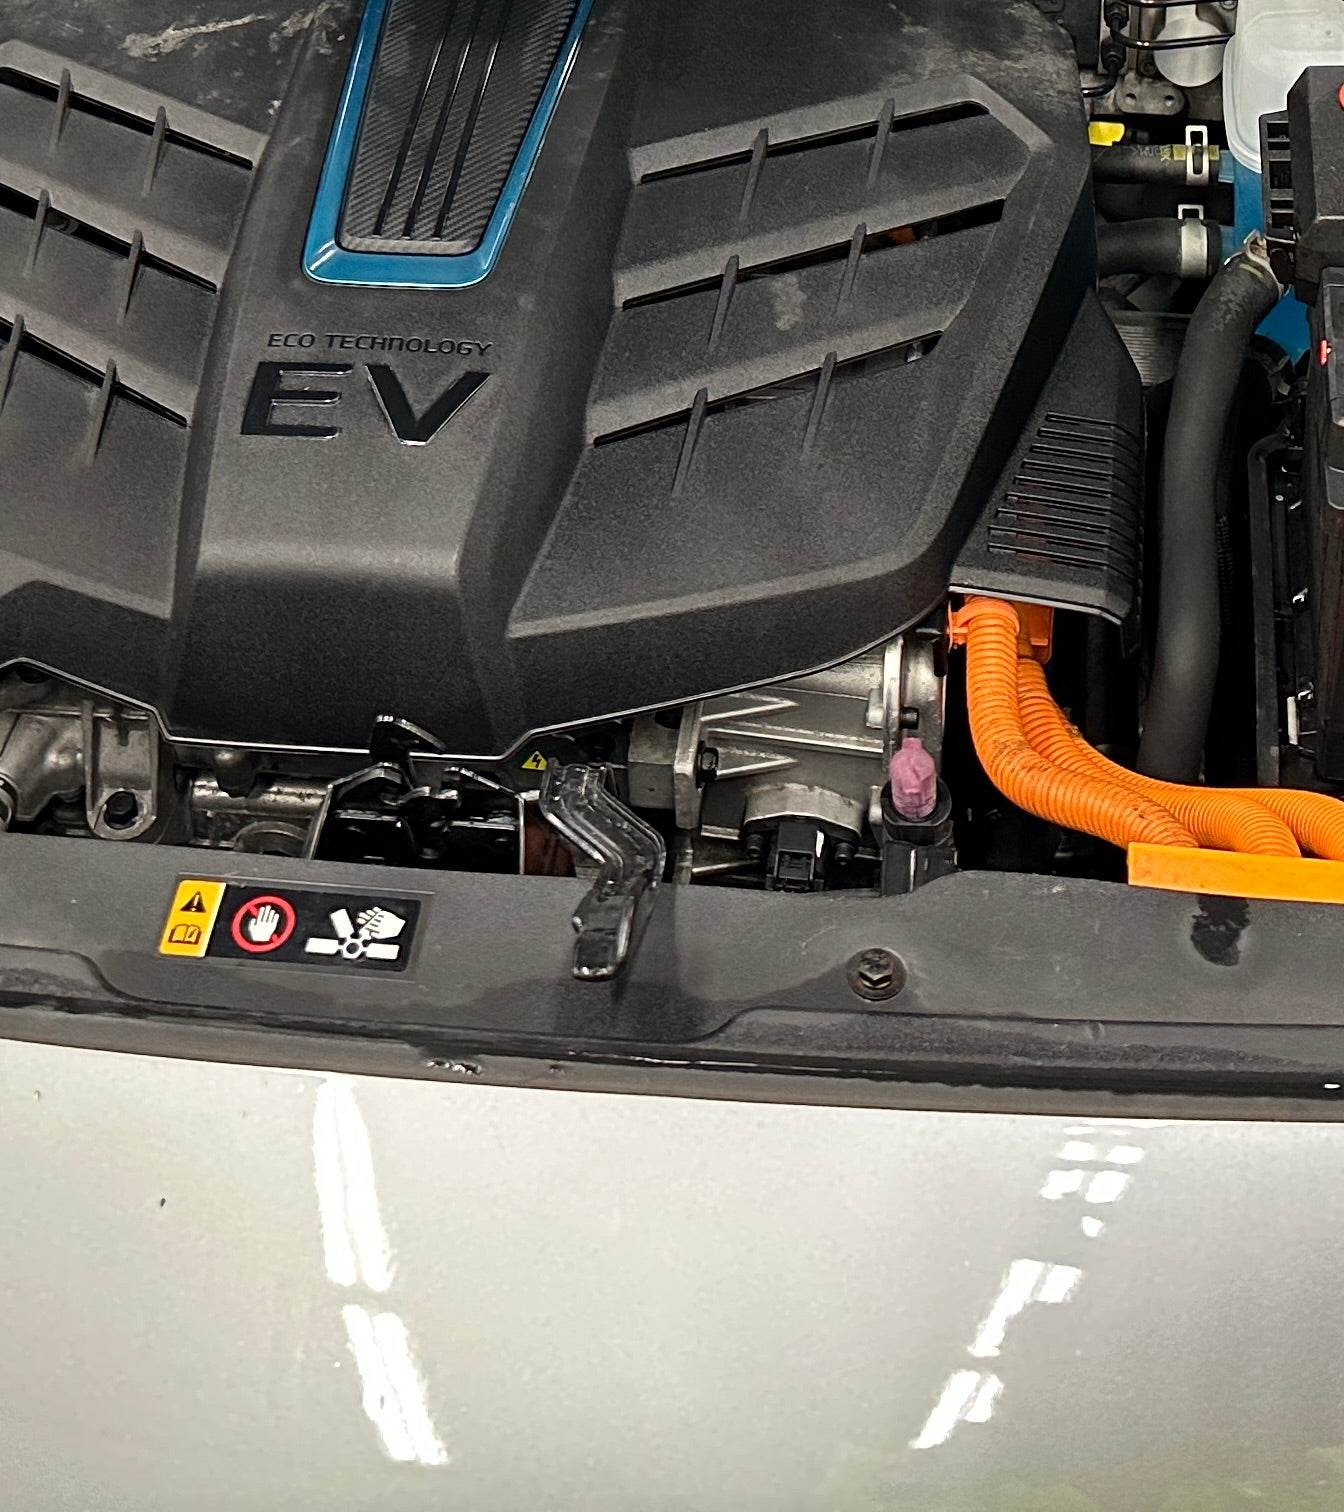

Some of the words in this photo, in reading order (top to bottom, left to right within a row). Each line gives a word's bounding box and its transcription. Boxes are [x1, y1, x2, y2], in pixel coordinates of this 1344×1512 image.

[267, 333, 315, 349] ECO
[325, 333, 494, 357] TECHNOLOGY
[240, 361, 491, 446] EV
